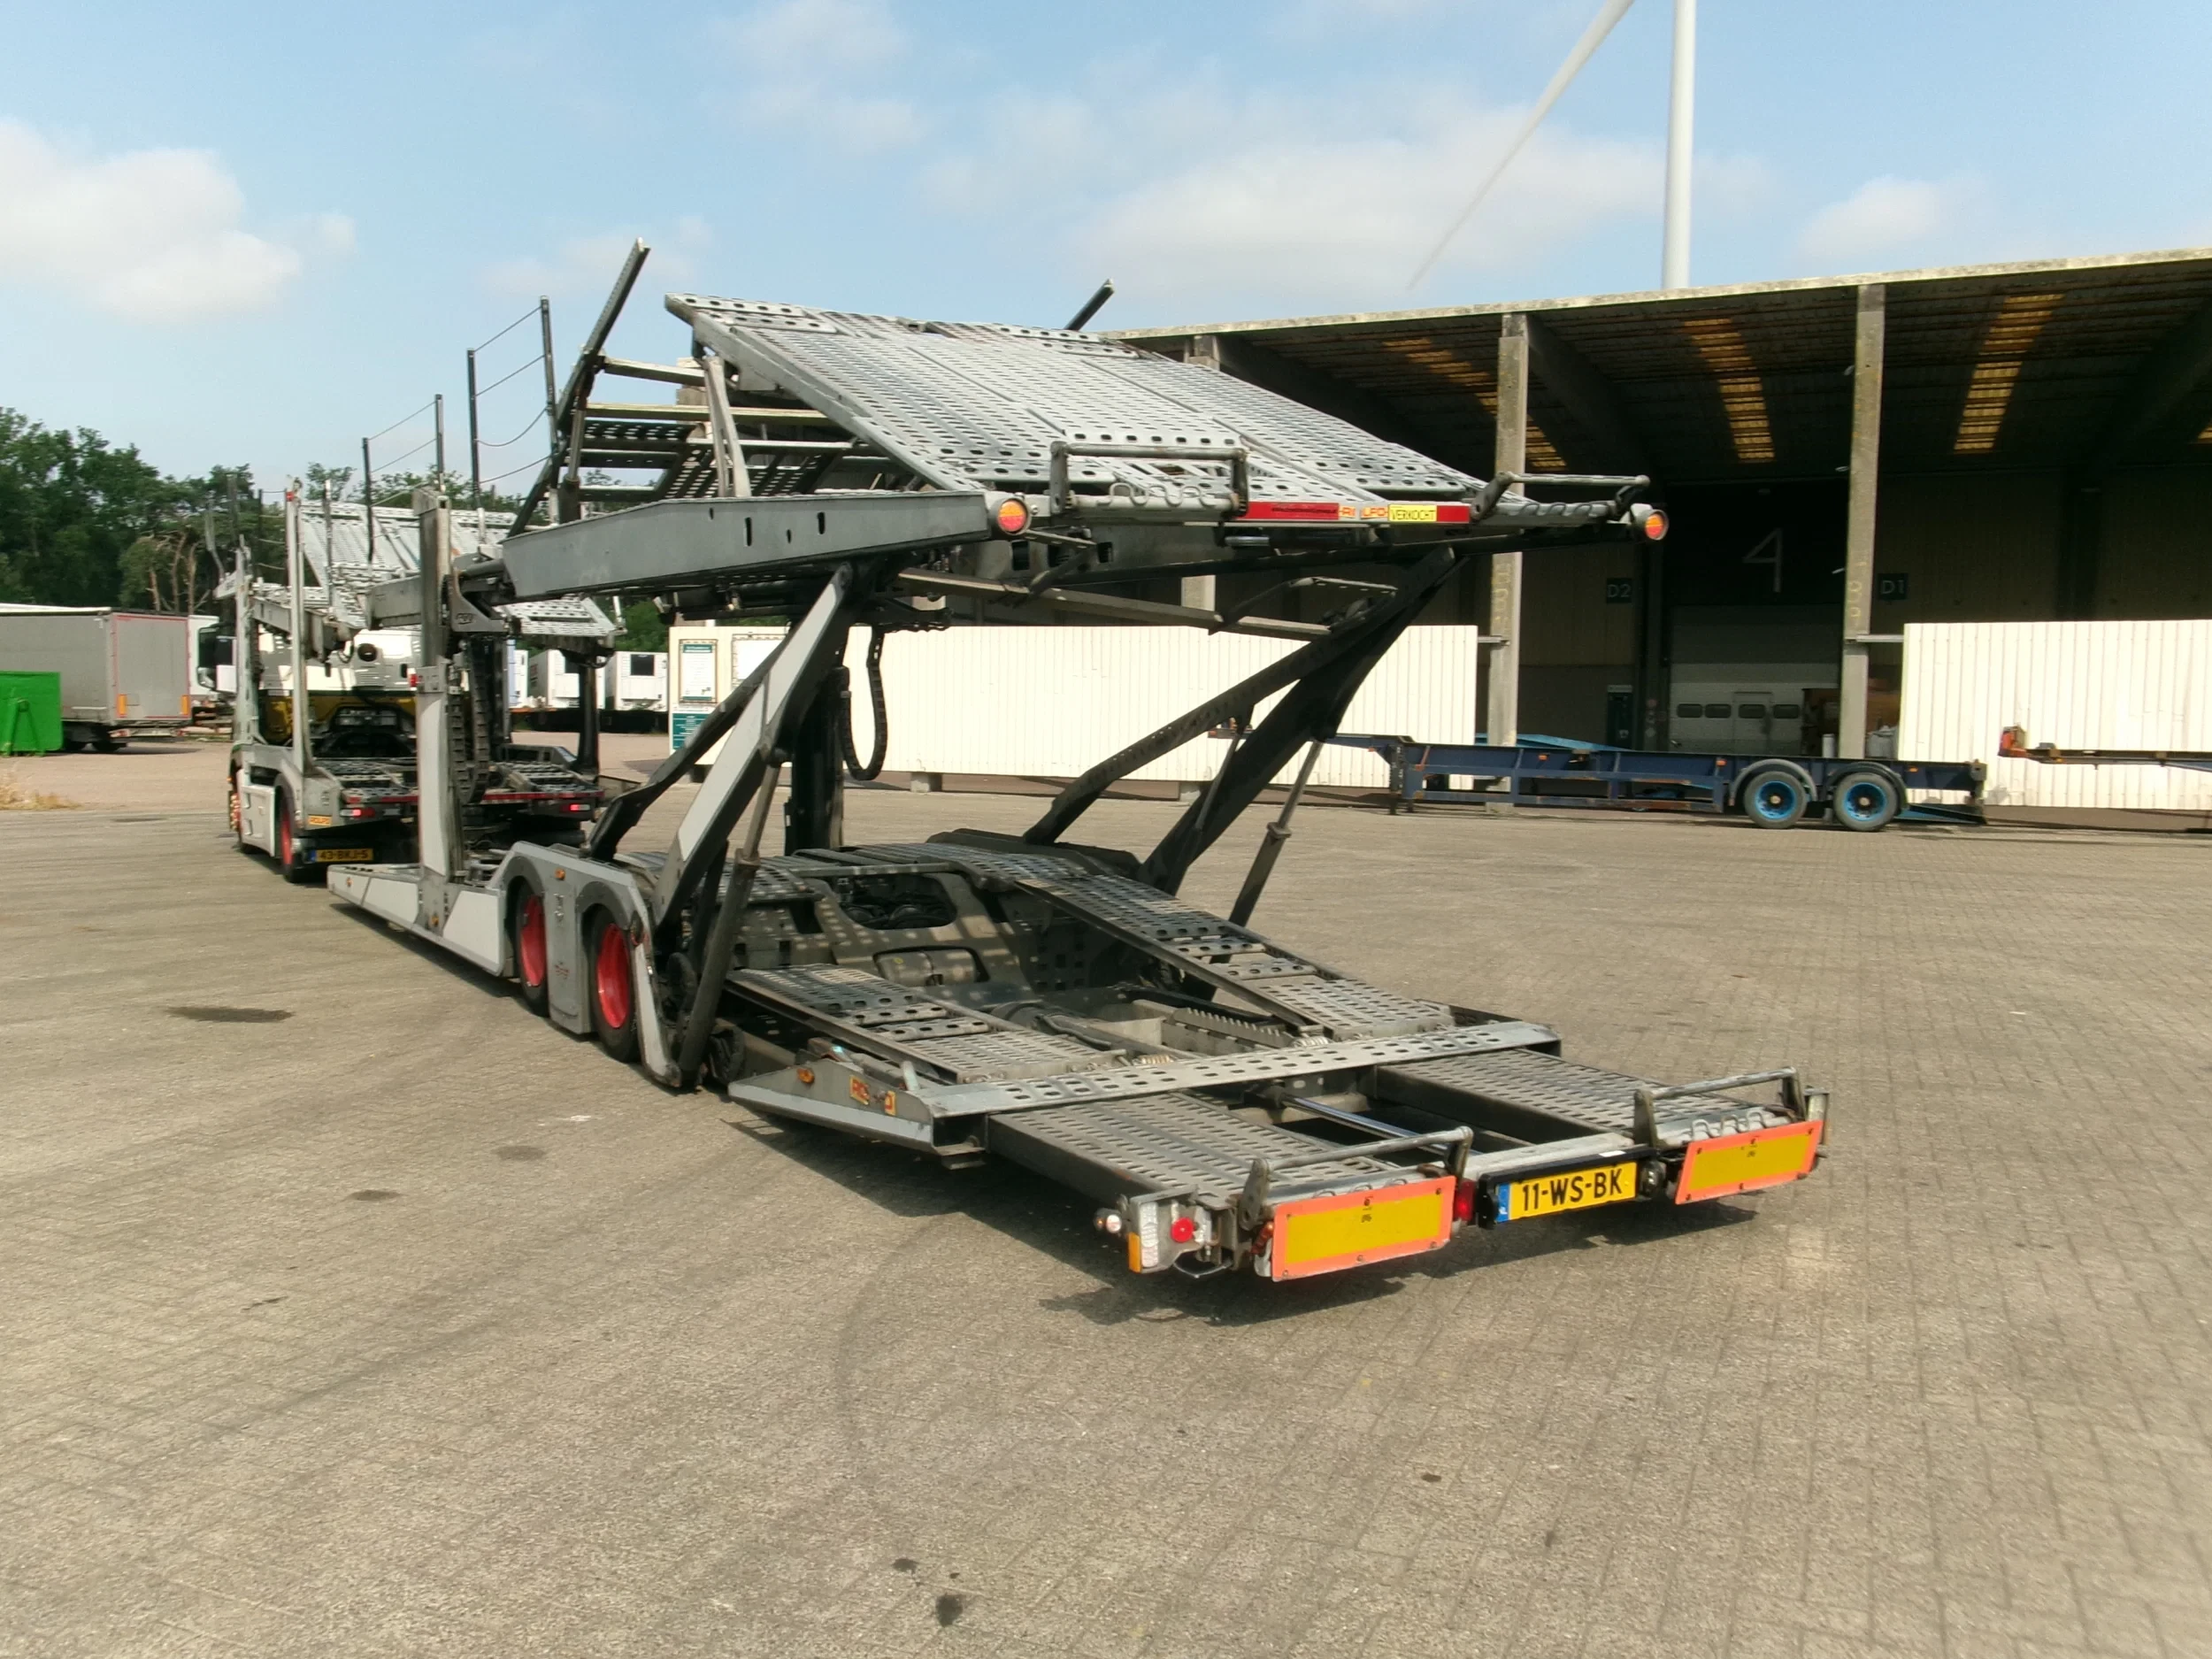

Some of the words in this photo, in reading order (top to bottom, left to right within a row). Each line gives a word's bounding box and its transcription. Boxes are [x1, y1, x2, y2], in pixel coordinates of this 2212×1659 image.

[1391, 510, 1435, 521] VERKOCHT
[1742, 527, 1783, 593] 4
[1608, 584, 1632, 597] D2
[1882, 580, 1905, 594] D1
[1522, 1168, 1623, 1211] 11-WS-BK
